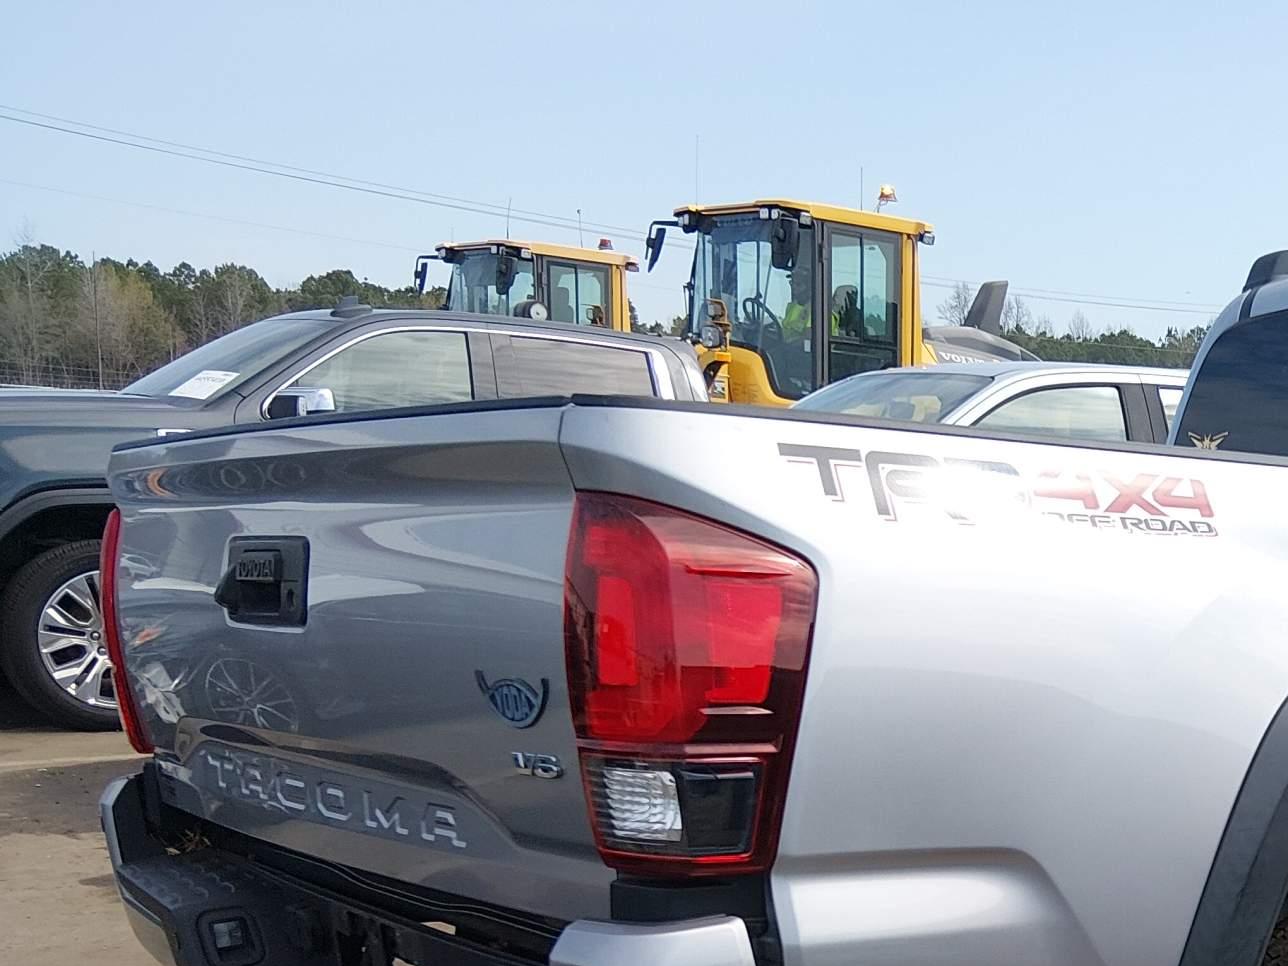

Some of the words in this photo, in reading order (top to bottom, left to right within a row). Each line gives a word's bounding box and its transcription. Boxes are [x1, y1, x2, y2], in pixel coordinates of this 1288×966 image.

[1119, 516, 1218, 537] ROAD
[511, 751, 563, 779] V6
[207, 751, 467, 849] TACOMA
